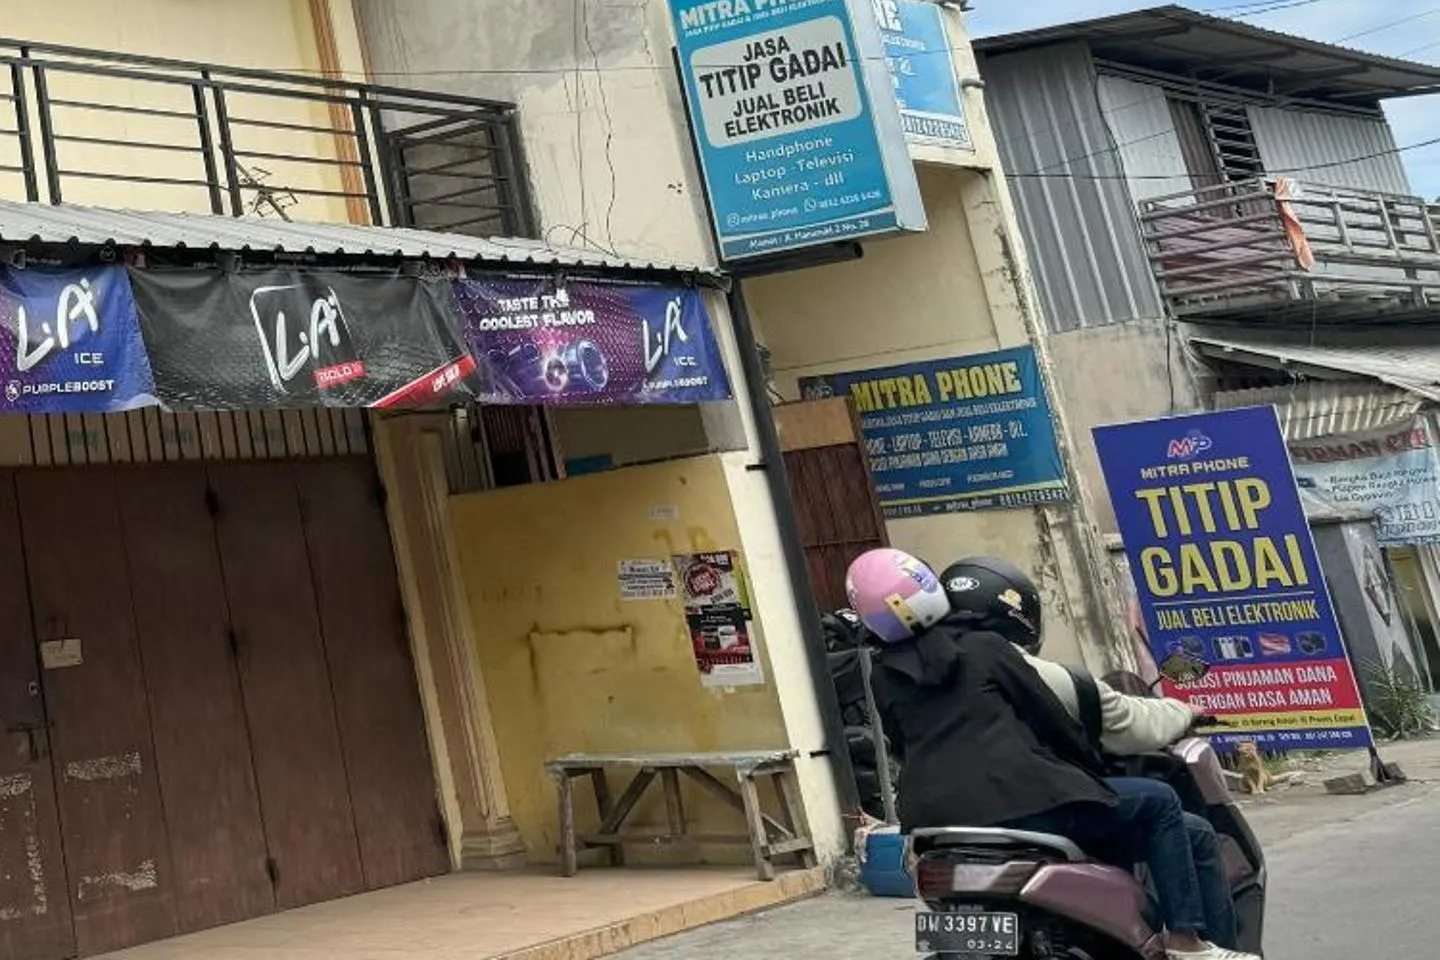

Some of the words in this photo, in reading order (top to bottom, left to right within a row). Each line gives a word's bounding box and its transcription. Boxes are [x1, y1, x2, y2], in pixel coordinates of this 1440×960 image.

[743, 35, 790, 62] JASA
[699, 63, 761, 98] TITIP
[769, 42, 847, 83] GADAI
[733, 93, 780, 117] JUAL
[783, 81, 826, 106] BELI
[724, 97, 841, 138] ELEKTRONIK
[745, 136, 833, 163] Handphone
[734, 167, 786, 188] Laptop
[752, 180, 809, 201] Kamera
[825, 172, 844, 187] dll
[497, 297, 538, 311] TASTE
[480, 314, 538, 331] COOLEST
[542, 309, 596, 326] FLAVOR
[74, 352, 104, 365] ICE
[673, 356, 697, 366] ICE
[22, 380, 115, 394] PURPLEBOOST
[850, 374, 932, 412] MITRA
[936, 361, 1022, 401] PHONE
[1140, 463, 1190, 480] MITRA
[1192, 456, 1250, 474] PHONE
[1135, 477, 1272, 539] TITIP
[1140, 533, 1309, 597] GADAI
[1156, 606, 1191, 631] JUAL
[1191, 603, 1225, 628] BELI
[1226, 599, 1320, 625] ELEKTRONIK
[1223, 668, 1295, 688] PINJAMAN
[1295, 665, 1338, 683] DANA
[1189, 693, 1247, 710] DENGAN
[1247, 691, 1288, 708] RASA
[1289, 689, 1334, 706] AMAN
[917, 915, 940, 933] DW
[944, 916, 988, 933] 3397
